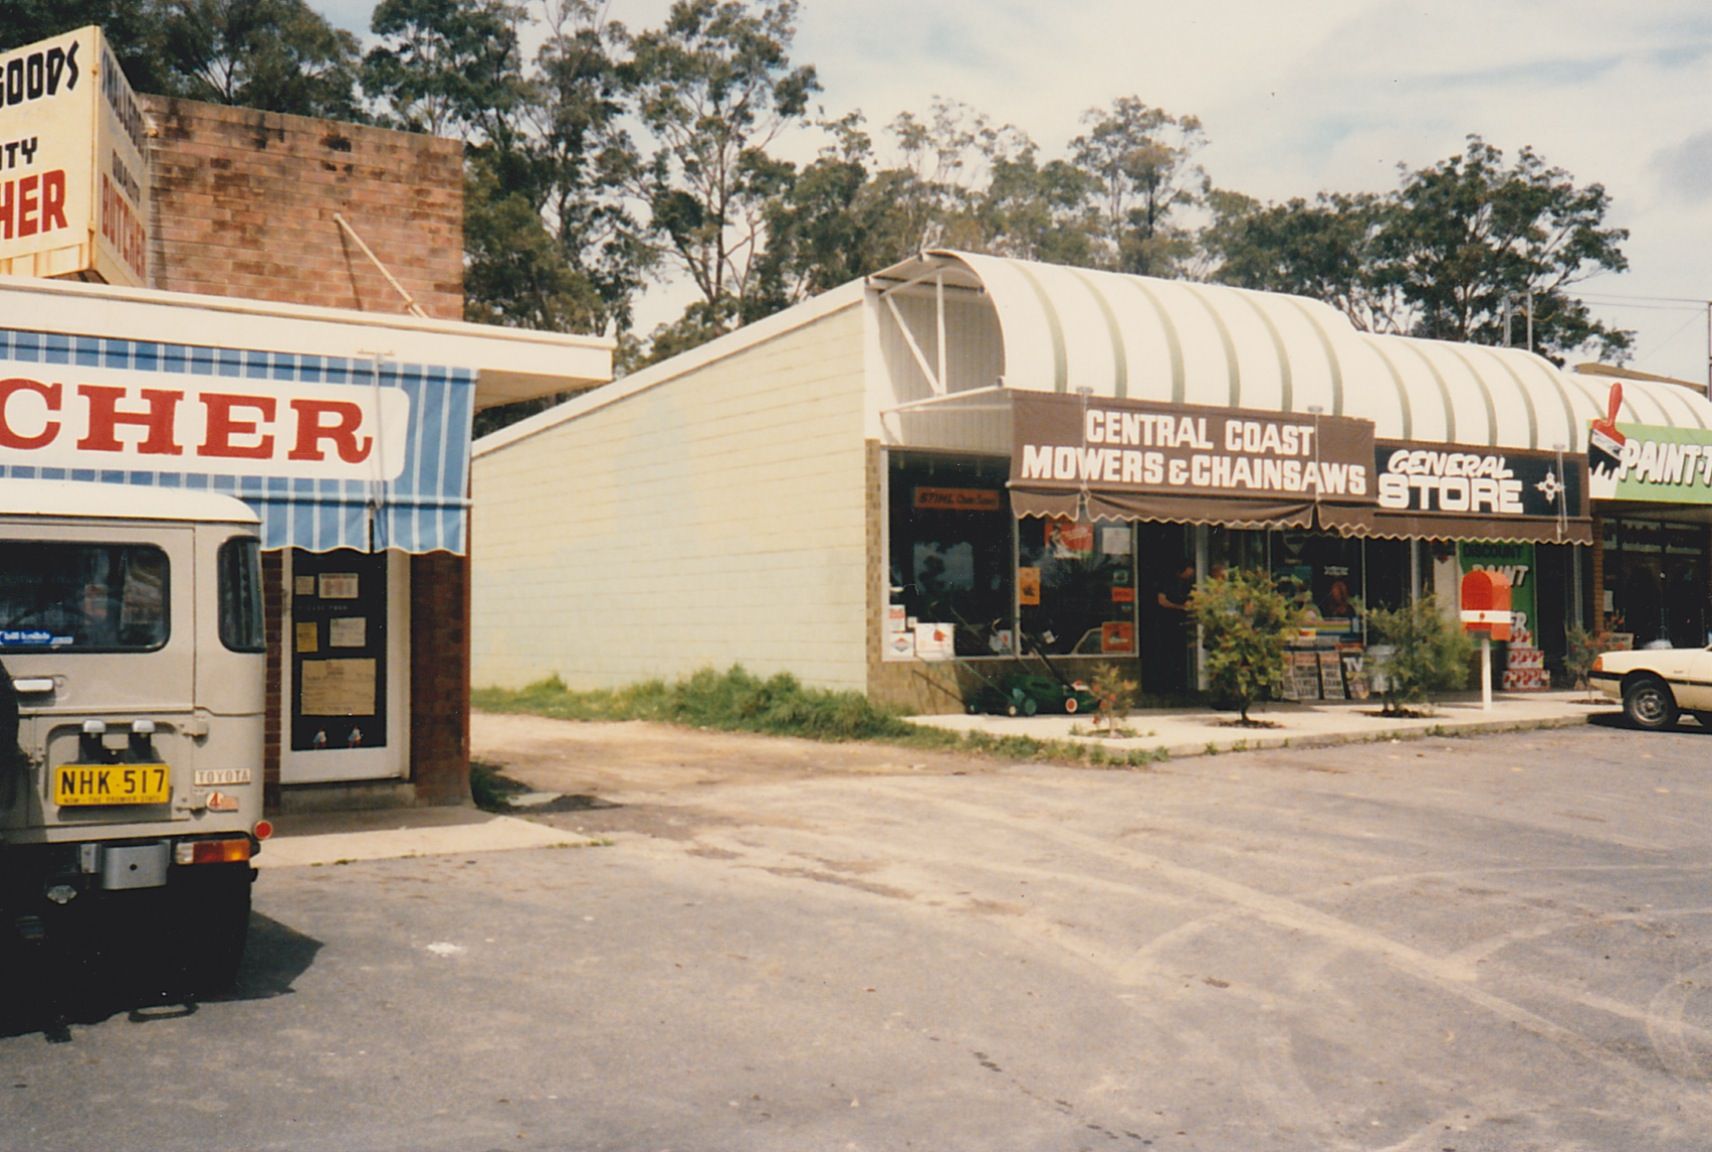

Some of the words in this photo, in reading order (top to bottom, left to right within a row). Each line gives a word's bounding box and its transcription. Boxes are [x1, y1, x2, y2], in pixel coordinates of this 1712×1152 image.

[0, 40, 79, 109] OODS
[0, 378, 373, 464] CHER
[1086, 409, 1214, 450] CENTRAL
[1225, 420, 1316, 457] COAST
[1021, 444, 1164, 485] MOWERS
[1168, 459, 1190, 485] &
[1191, 455, 1366, 496] CHAINSAWS
[1387, 449, 1513, 479] GENERAL
[1378, 473, 1524, 514] STORE
[61, 770, 111, 795] NHK
[123, 769, 165, 794] 517
[199, 770, 249, 783] TOYOTA
